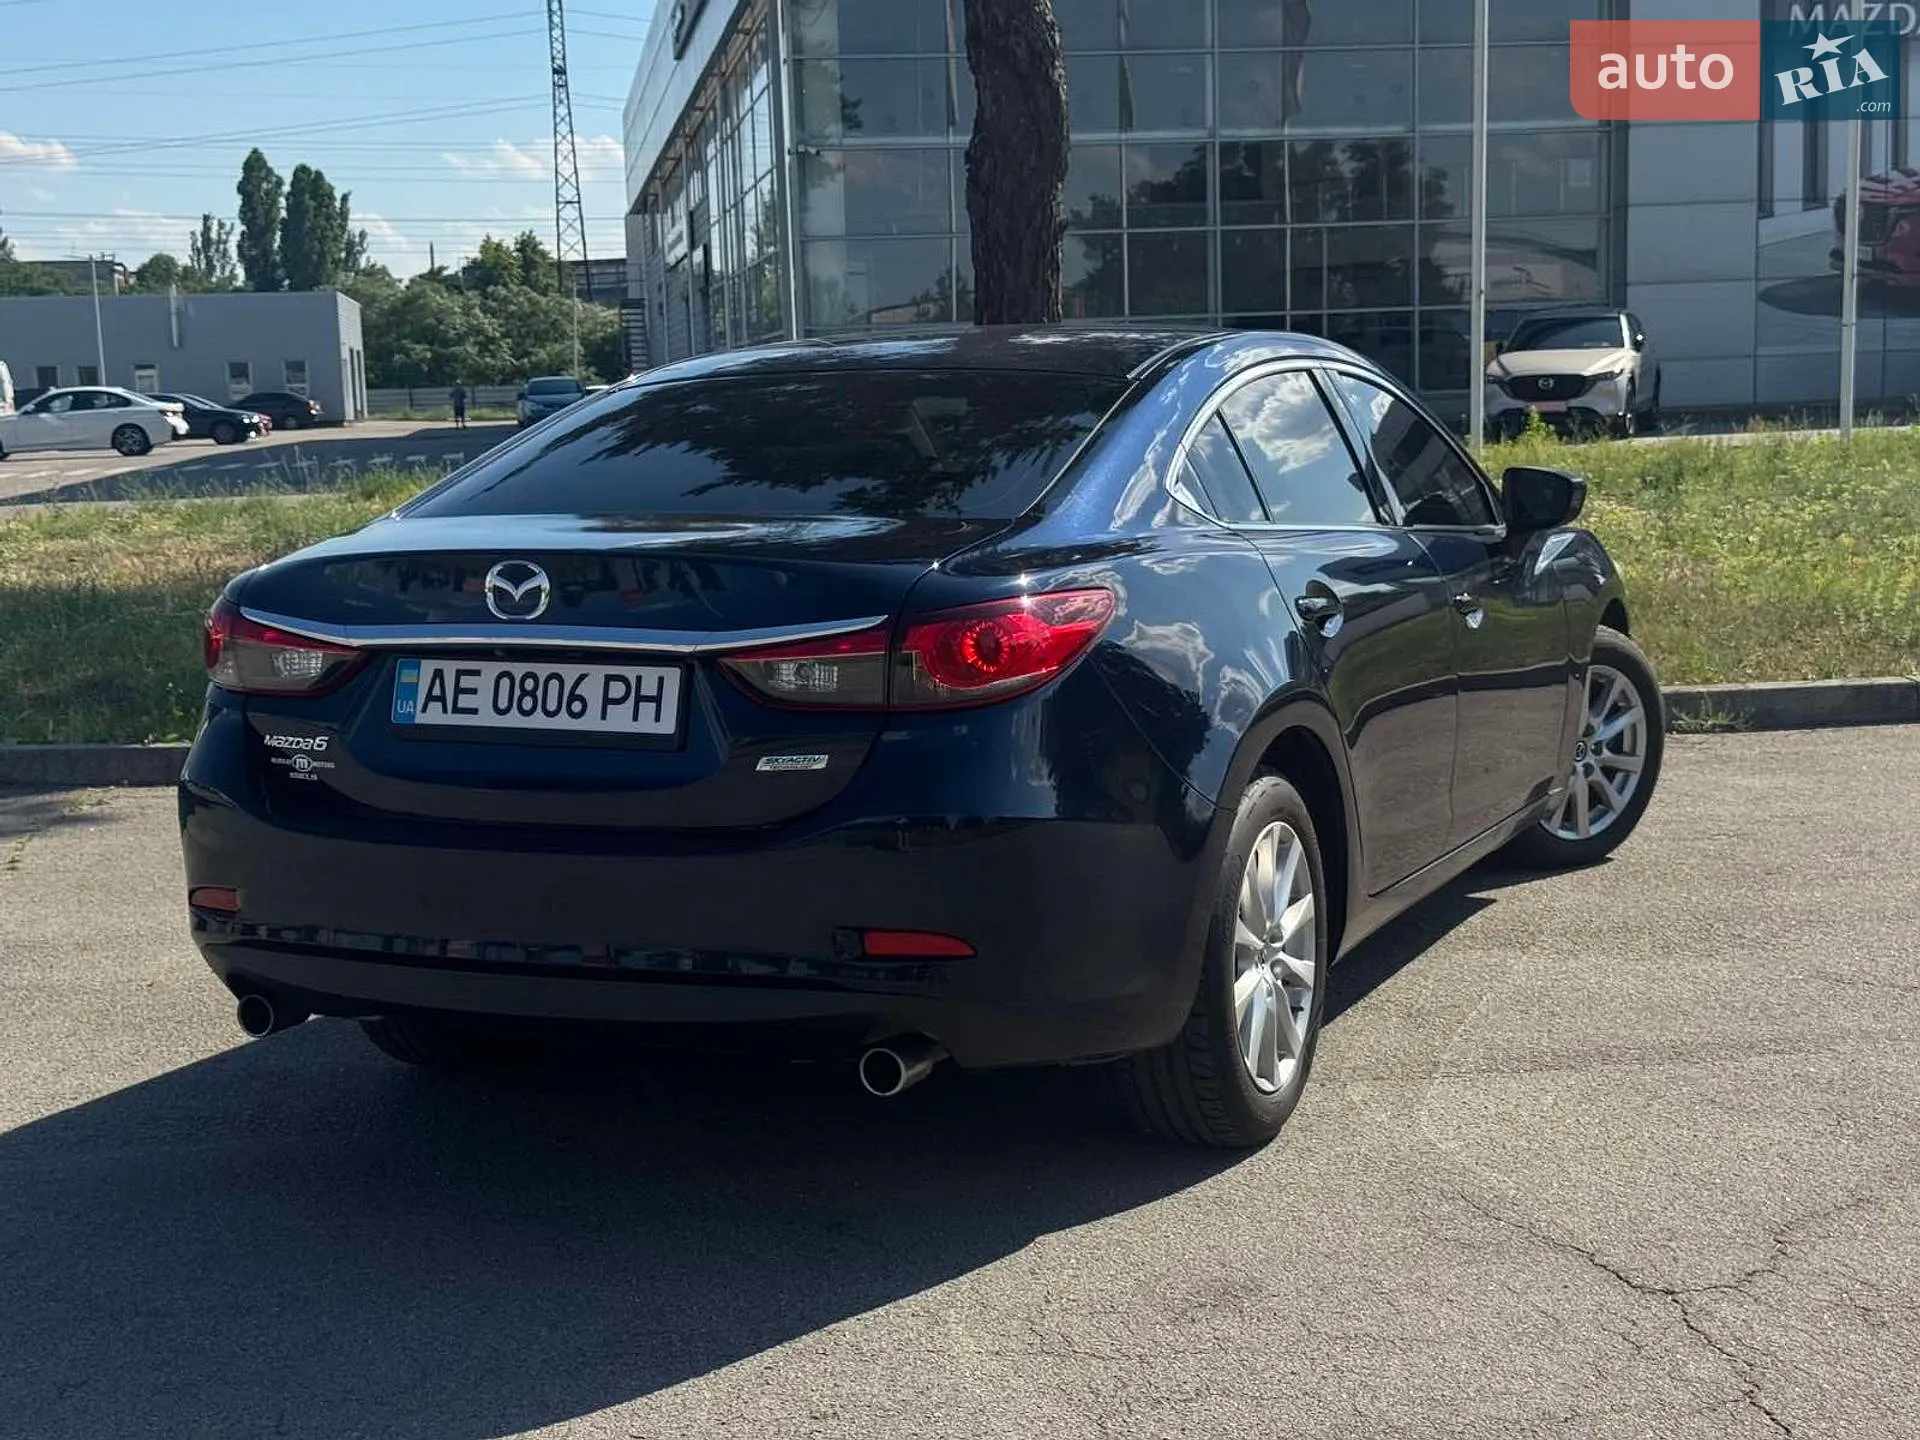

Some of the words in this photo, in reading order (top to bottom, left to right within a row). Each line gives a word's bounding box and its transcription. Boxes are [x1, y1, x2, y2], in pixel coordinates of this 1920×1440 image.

[1788, 2, 1920, 37] MAZD
[397, 699, 414, 714] UA
[420, 668, 482, 715] AE
[491, 670, 590, 720] 0806
[600, 673, 665, 723] PH
